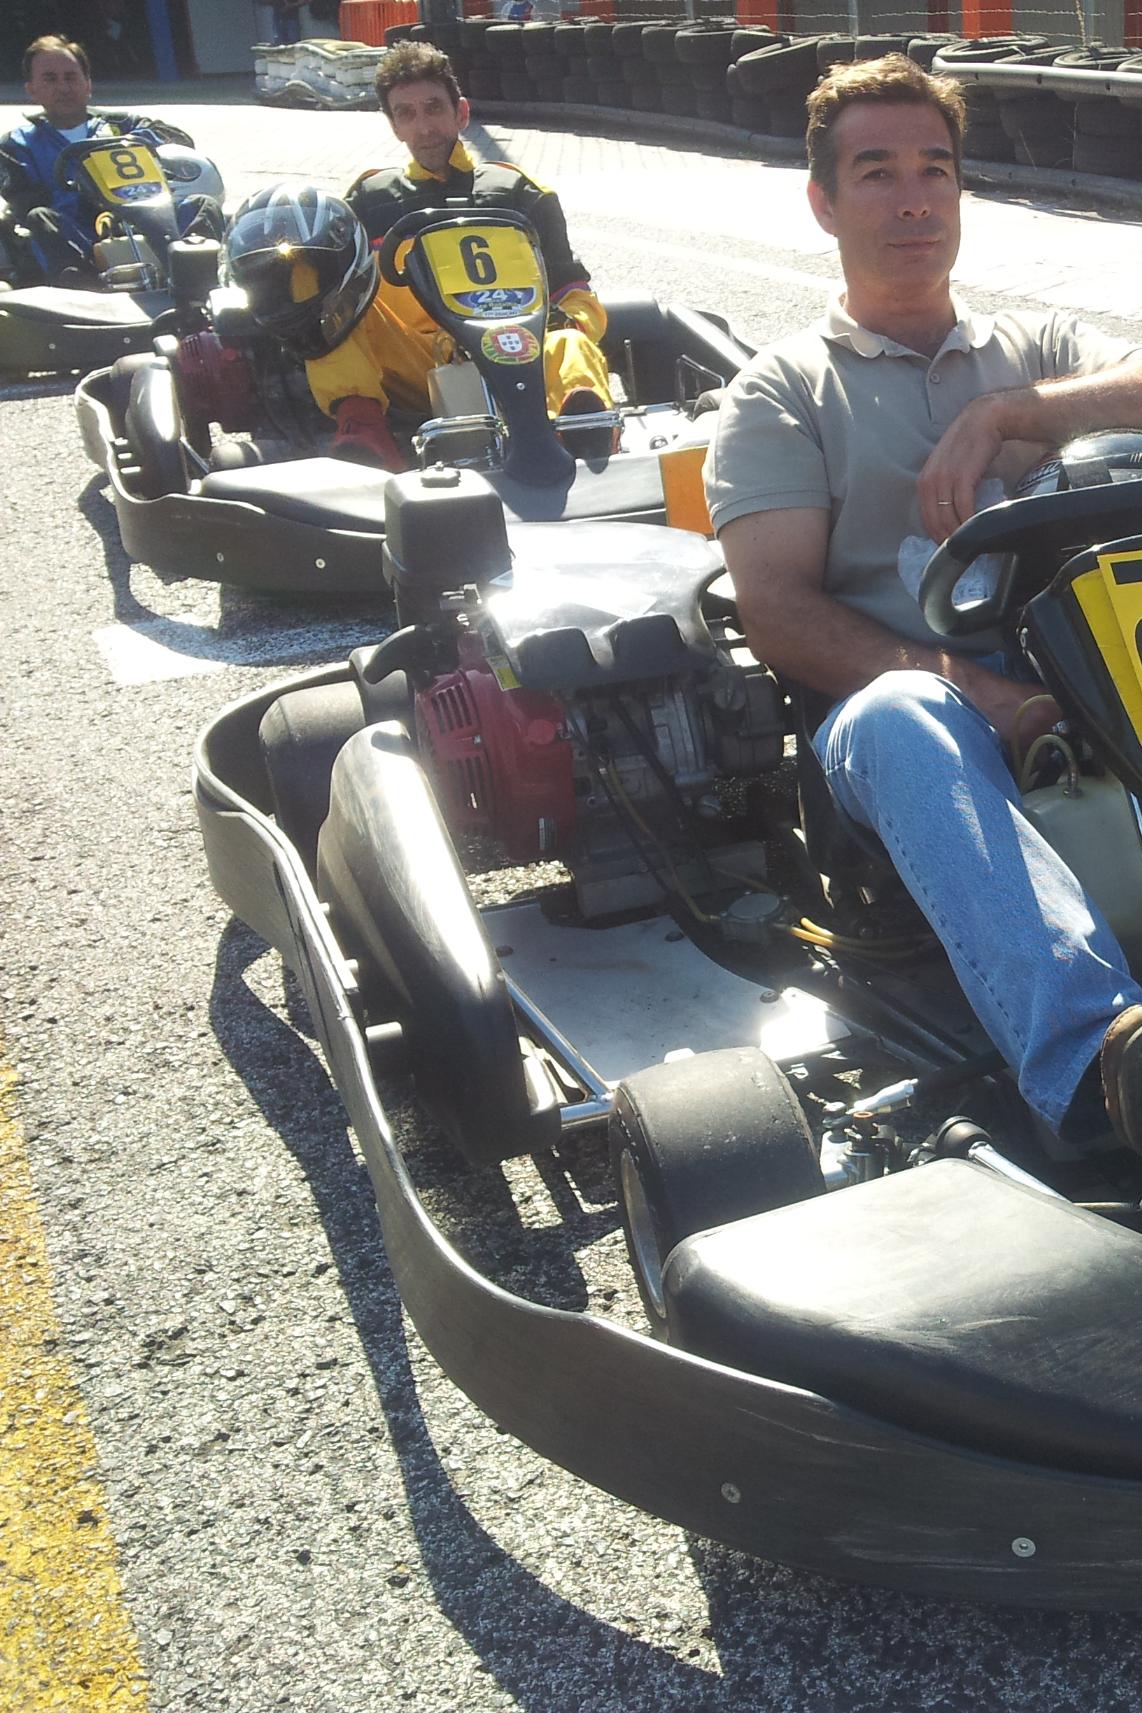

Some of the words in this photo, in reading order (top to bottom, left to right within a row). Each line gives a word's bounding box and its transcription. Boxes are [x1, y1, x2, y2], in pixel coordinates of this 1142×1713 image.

[110, 150, 144, 179] 8
[459, 235, 497, 285] 6
[476, 289, 508, 303] 24
